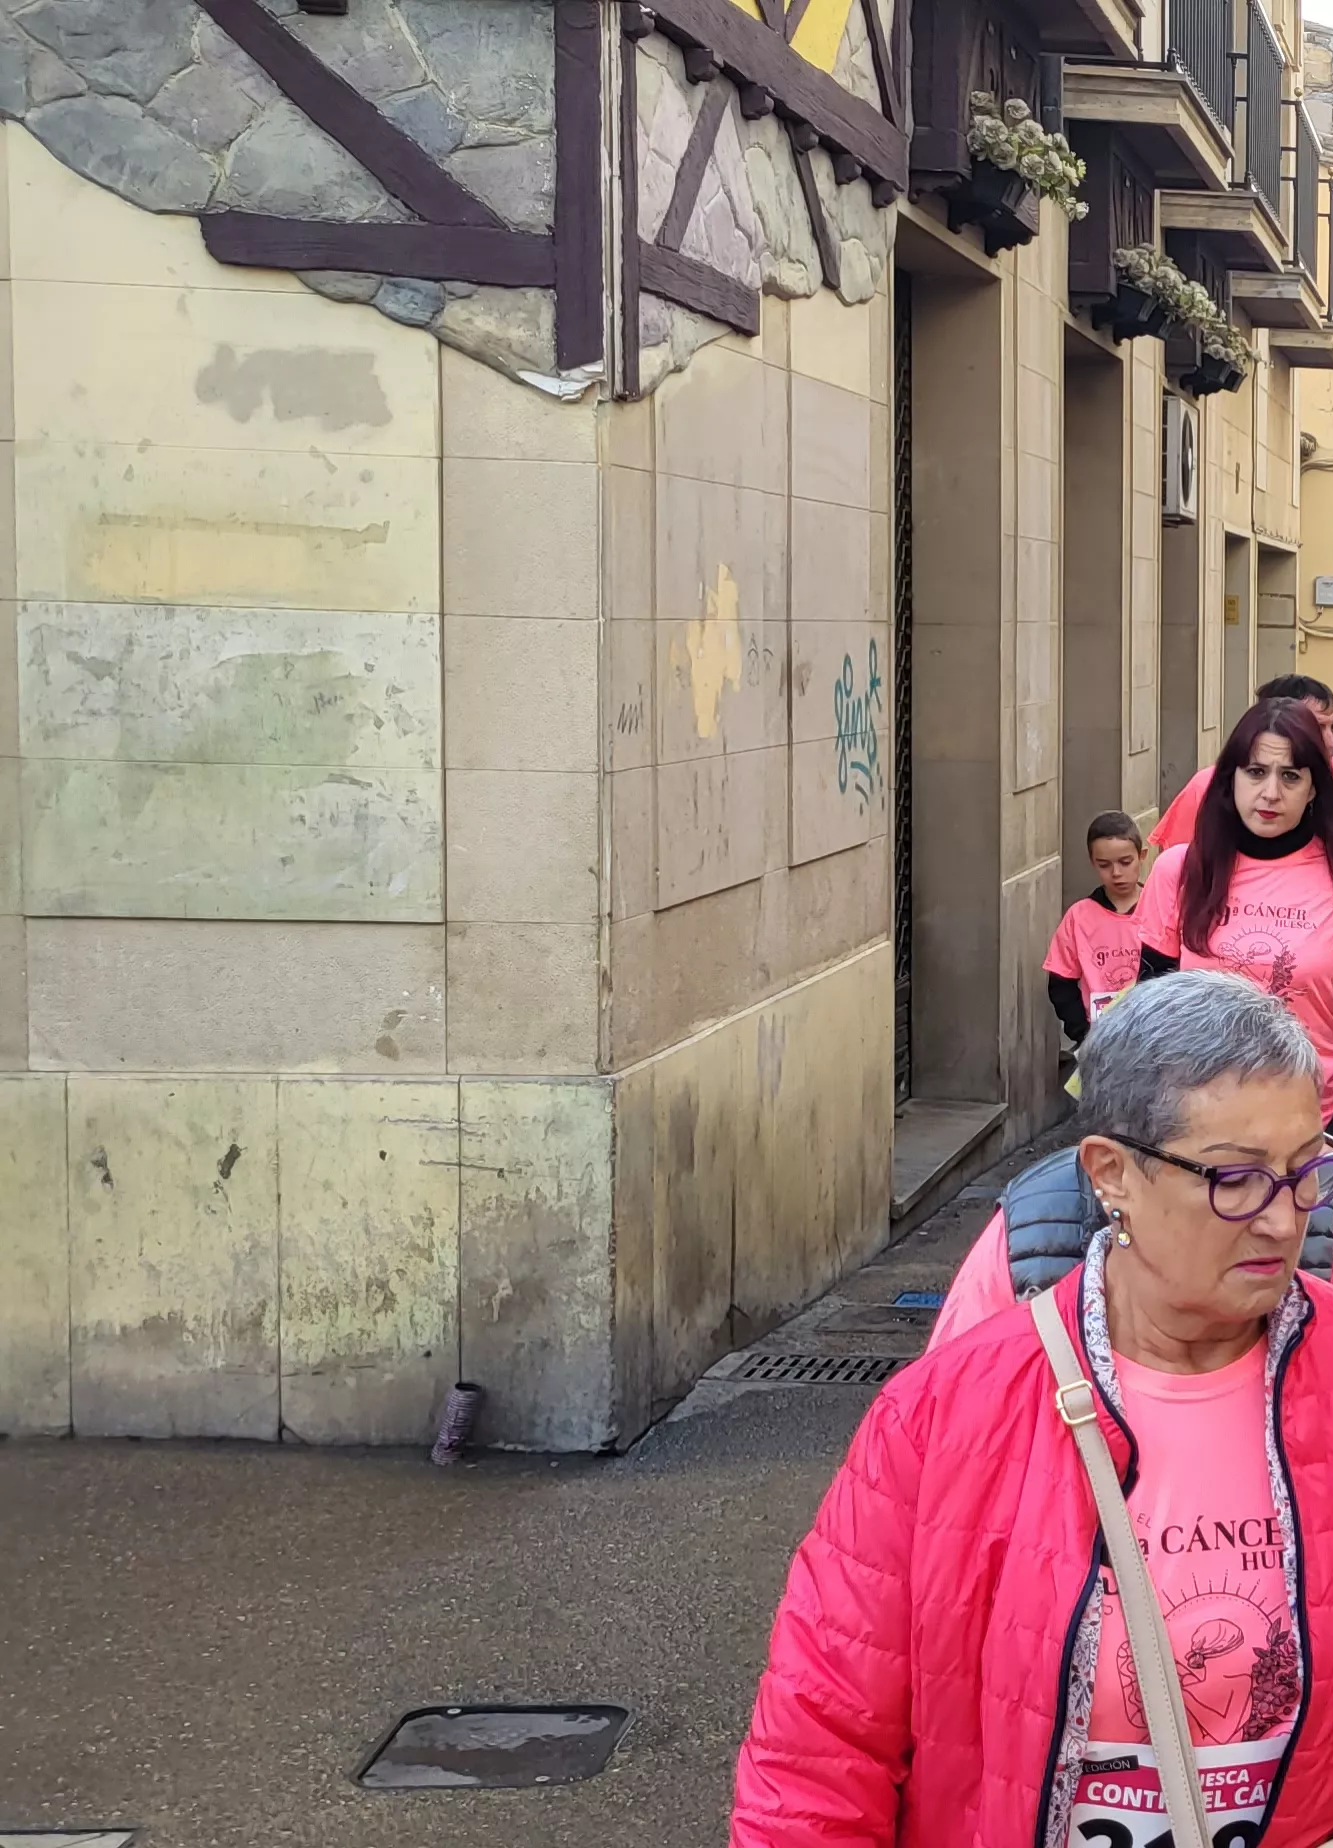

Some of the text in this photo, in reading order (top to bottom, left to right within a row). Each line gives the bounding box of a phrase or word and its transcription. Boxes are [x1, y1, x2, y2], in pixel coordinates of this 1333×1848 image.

[1244, 902, 1307, 921] CÁNCER
[1275, 919, 1317, 930] HUESCA
[1112, 946, 1140, 958] CÁNC
[1159, 1514, 1284, 1555] CÁNCE
[1200, 1768, 1250, 1788] UESCA
[1086, 1781, 1168, 1810] CONT
[1203, 1789, 1227, 1808] EL
